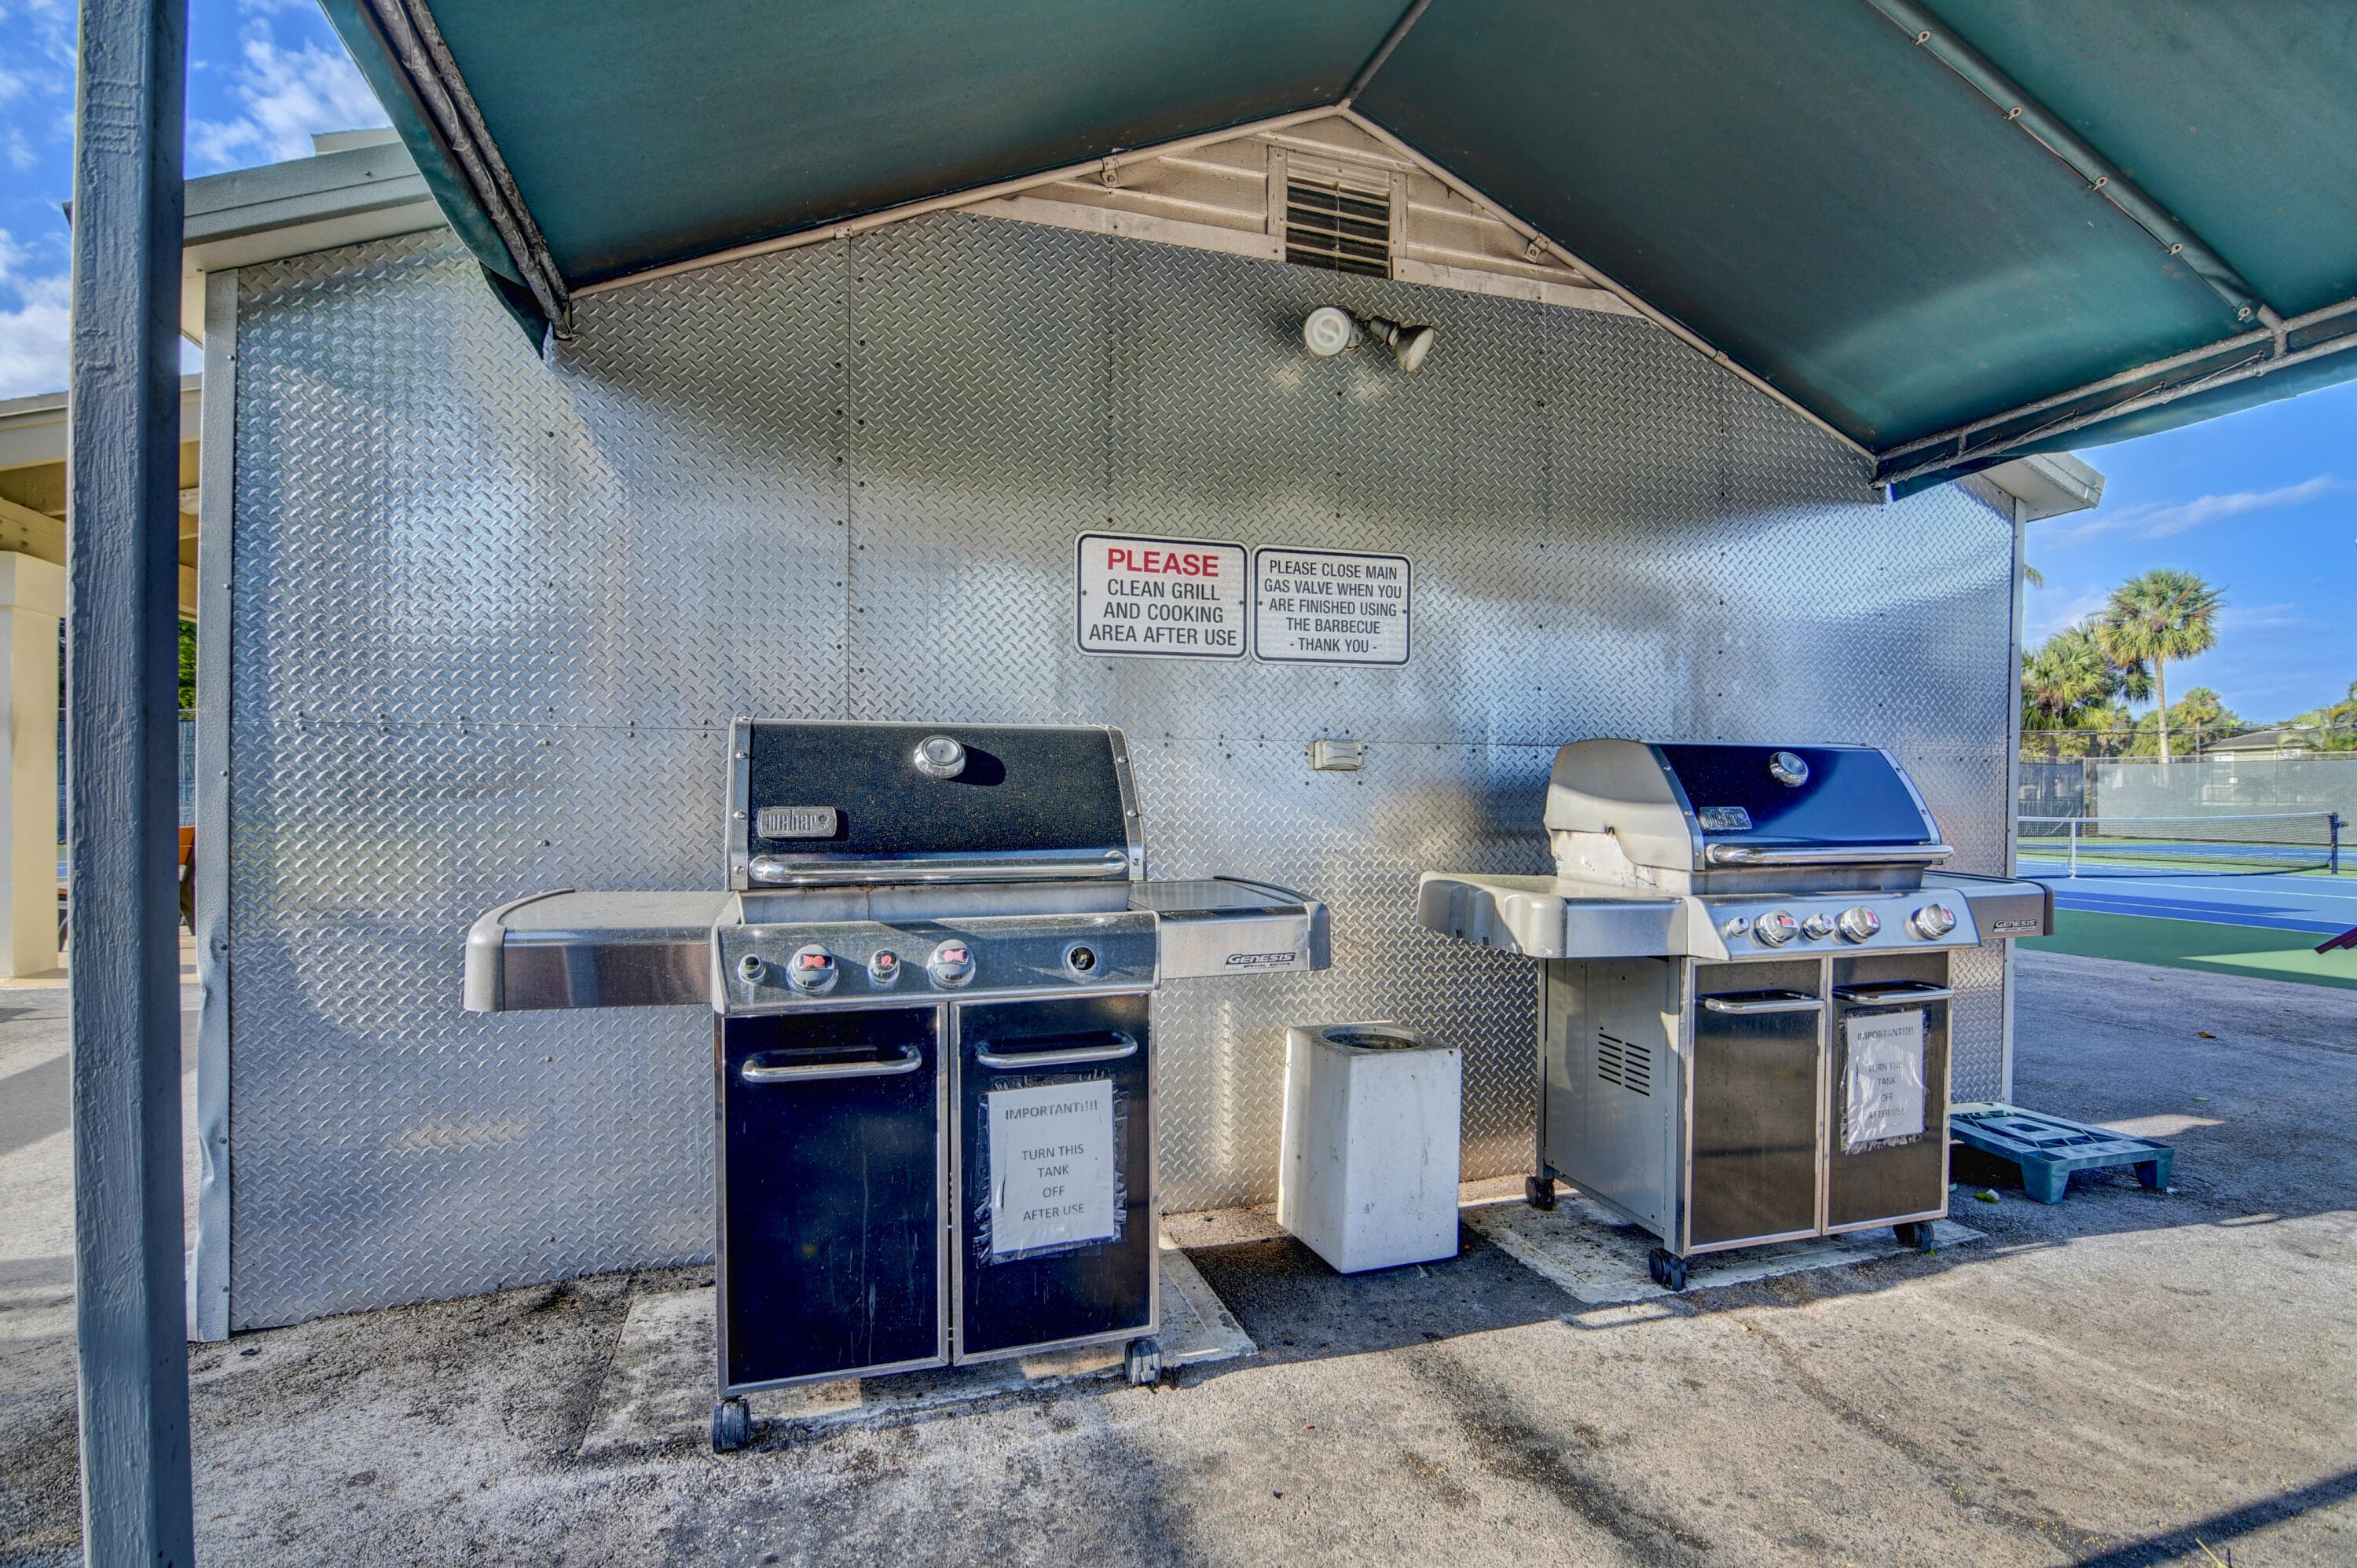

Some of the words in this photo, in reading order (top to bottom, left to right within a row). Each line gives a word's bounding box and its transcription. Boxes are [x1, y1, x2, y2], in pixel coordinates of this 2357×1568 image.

[1108, 548, 1219, 577] PLEASE
[1270, 560, 1317, 576] PLEASE
[1321, 563, 1362, 577] CLOSE
[1365, 566, 1397, 580] MAIN
[1108, 579, 1164, 597] CLEAN
[1172, 583, 1220, 601] GRILL
[1264, 579, 1289, 592] GAS
[1295, 581, 1332, 595] VALVE
[1337, 583, 1373, 597] WHEN
[1378, 585, 1401, 599] YOU
[1103, 602, 1140, 619] AND
[1148, 604, 1223, 623] COOKING
[1270, 598, 1295, 612] ARE
[1299, 599, 1354, 614] FINISHED
[1360, 603, 1396, 617] USING
[1286, 617, 1310, 632] THE
[1315, 619, 1380, 634] BARBECUE
[1089, 625, 1137, 642] AREA
[1143, 627, 1197, 644] AFTER
[1205, 629, 1237, 646] USE
[1299, 638, 1340, 651] THANK
[1345, 639, 1369, 653] YOU
[766, 809, 817, 830] weber
[1228, 954, 1293, 963] GENESIS
[1868, 1064, 1887, 1072] TURN
[1878, 1076, 1896, 1086] TANK
[1880, 1093, 1893, 1102] OFF
[1868, 1109, 1890, 1119] AFTER
[1022, 1147, 1054, 1161] TURN
[1058, 1144, 1084, 1156] THIS
[1038, 1165, 1069, 1178] TANK
[1043, 1186, 1065, 1198] OFF
[1023, 1207, 1062, 1221] AFTER
[1064, 1203, 1084, 1215] USE
